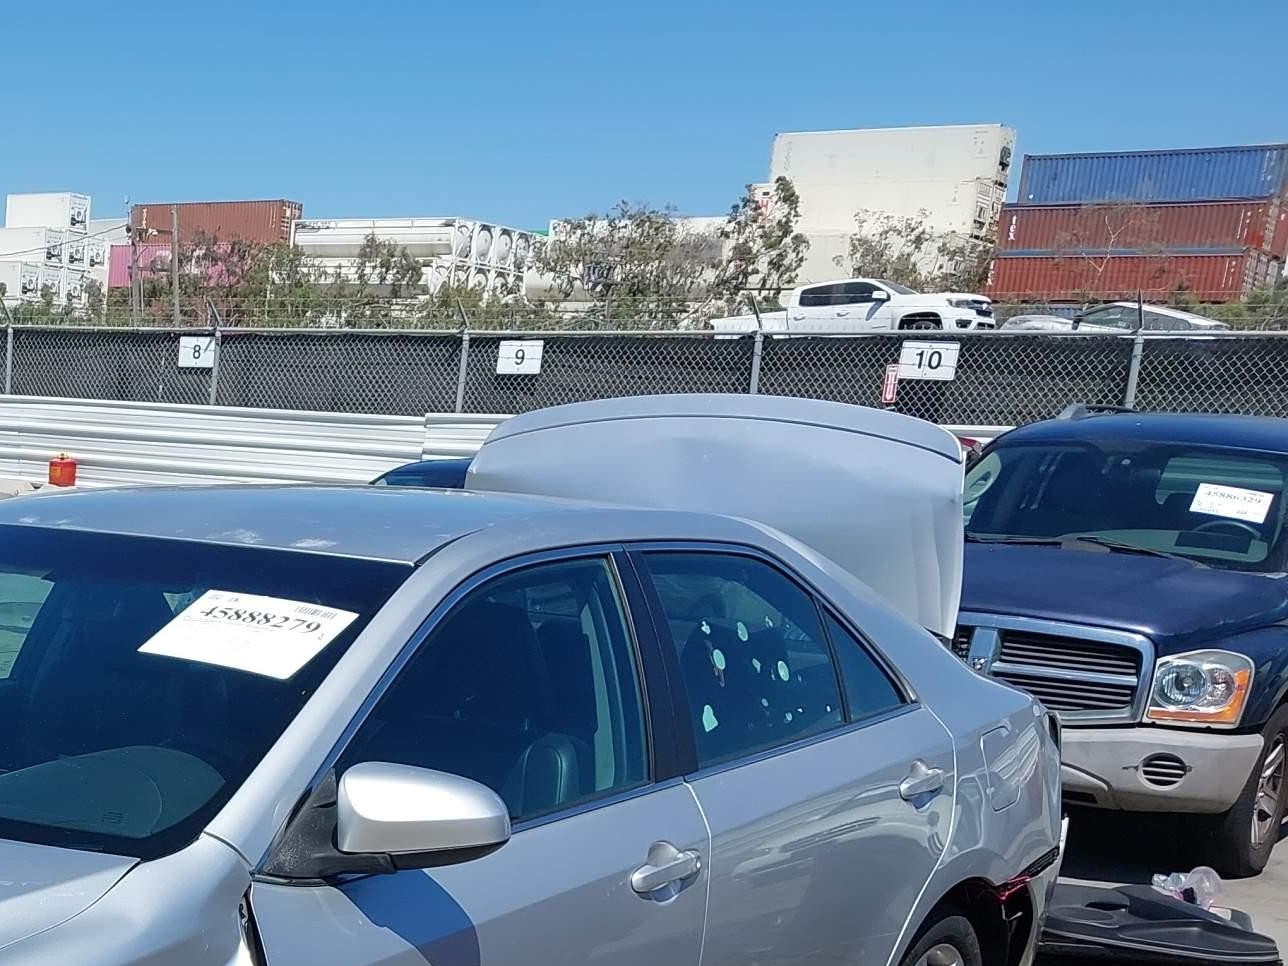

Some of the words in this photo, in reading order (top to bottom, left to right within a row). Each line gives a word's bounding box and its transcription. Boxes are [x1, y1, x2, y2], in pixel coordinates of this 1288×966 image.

[192, 344, 201, 360] 8
[514, 348, 525, 366] 9
[915, 349, 943, 371] 10
[200, 605, 322, 634] 45888279
